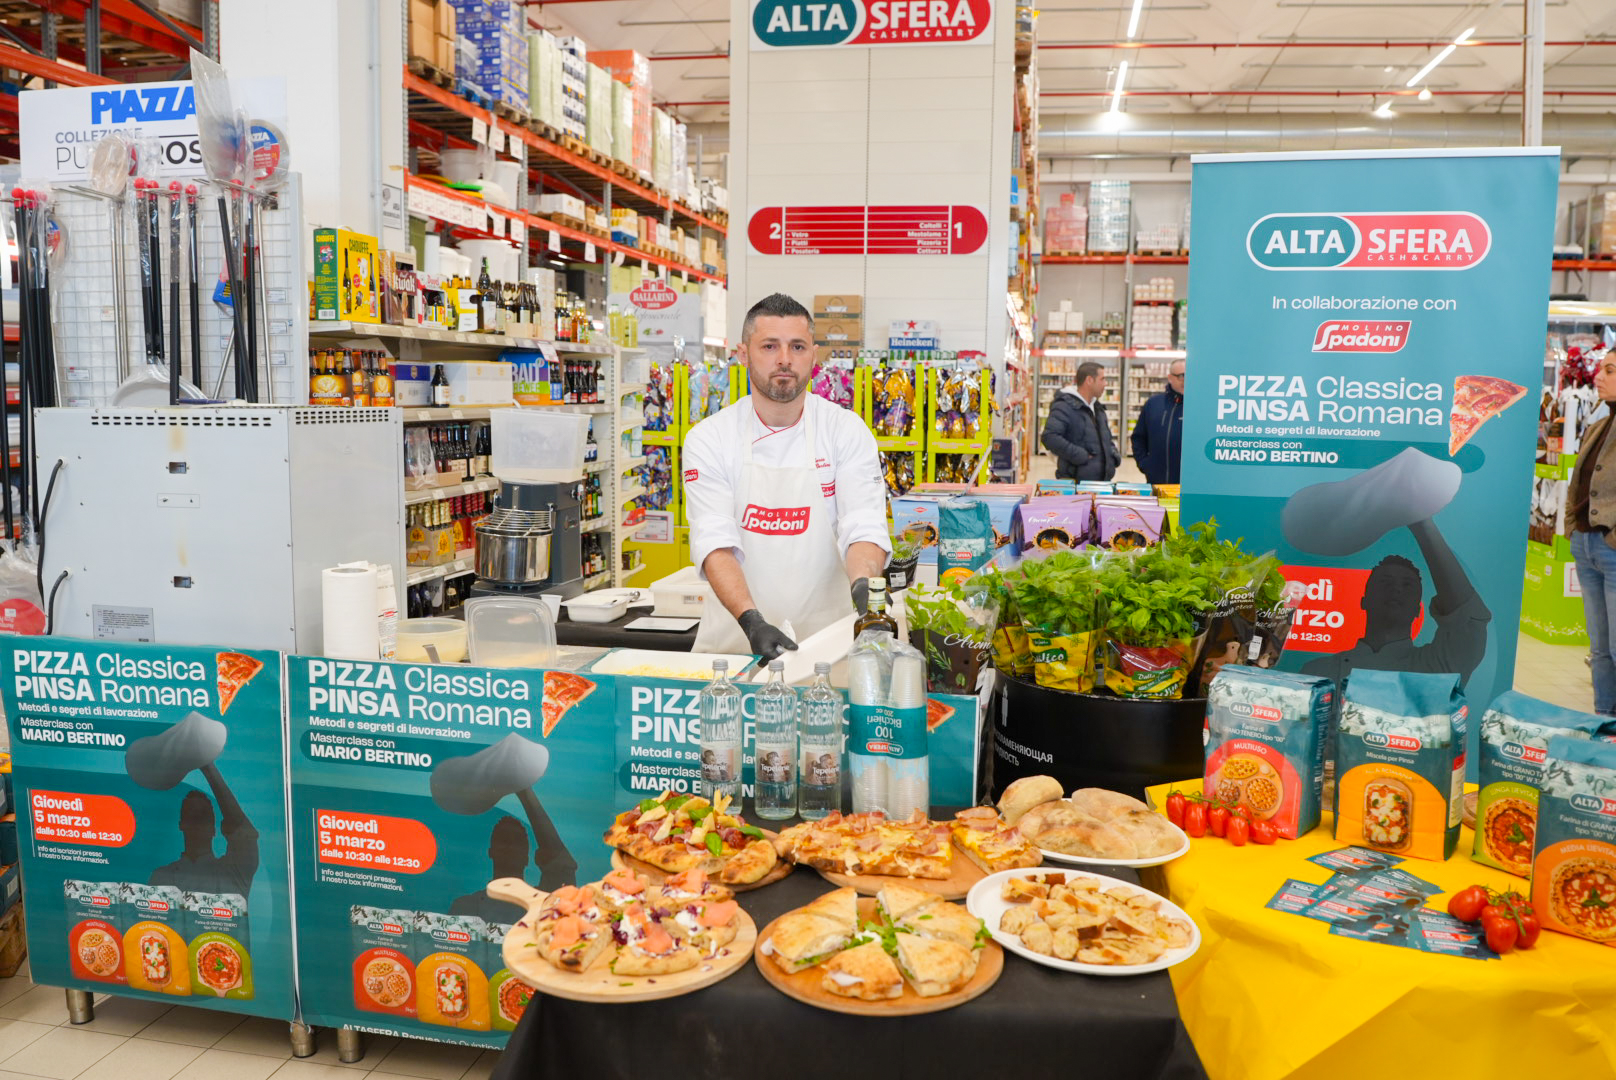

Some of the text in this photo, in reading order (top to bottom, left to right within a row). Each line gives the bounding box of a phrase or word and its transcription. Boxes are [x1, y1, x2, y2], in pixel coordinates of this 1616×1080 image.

[766, 0, 976, 32] ALTA SFERA
[869, 29, 975, 39] CASH&CARRY
[91, 86, 196, 124] PIAZZA
[769, 223, 781, 239] 2
[954, 222, 962, 239] 1
[917, 239, 942, 247] Pizzeria
[1264, 229, 1473, 254] ALTA SFERA
[634, 292, 674, 302] BALLARINI
[1272, 296, 1456, 310] In collaborazione con
[890, 337, 933, 347] Heineken
[1314, 324, 1400, 350] Spadoni
[1218, 375, 1442, 400] PIZZA Classica
[1217, 399, 1442, 425] PINSA Romana
[1216, 424, 1253, 434] Metodi
[1265, 426, 1303, 437] segreti
[1306, 427, 1315, 436] di
[1317, 427, 1380, 437] lavorazione
[1215, 438, 1302, 449] Masterclass con
[1215, 449, 1338, 464] MARIO BERTINO
[742, 508, 804, 531] Spadoni
[759, 510, 806, 518] MOLINO
[1300, 633, 1331, 642] 12:30
[14, 650, 206, 681] PIZZA Classica
[308, 660, 529, 700] PIZZA Classica
[15, 676, 209, 707] PINSA Romana
[18, 702, 49, 712] Metodi
[59, 706, 91, 717] segreti
[93, 707, 102, 716] di
[103, 708, 158, 719] lavorazione
[309, 687, 531, 728] PINSA Romana
[1233, 704, 1279, 718] ALTA SFERA
[20, 717, 93, 730] Masterclass con
[309, 716, 471, 739] Metodi e segreti di lavorazione
[867, 715, 902, 728] Bicchieri
[22, 728, 126, 747] MARIO BERTINO
[875, 726, 893, 739] 100
[310, 732, 395, 749] Masterclass con
[1233, 742, 1267, 754] MULTIUSO
[1366, 735, 1416, 748] ALTA SFERA
[310, 744, 432, 767] MARIO BERTINO
[631, 746, 681, 759] Metodi e
[1504, 744, 1521, 755] ALTA
[631, 763, 701, 778] Masterclass
[1513, 766, 1536, 776] GRANO
[631, 776, 688, 792] MARIO
[33, 795, 83, 812] Giovedì
[1574, 797, 1600, 809] ALTA
[35, 811, 90, 827] 5 marzo
[320, 815, 378, 834] Giovedì
[1560, 814, 1581, 825] Farina
[36, 827, 122, 842] dalle 10:30 alle 12:30
[320, 831, 385, 851] 5 marzo
[57, 848, 82, 856] iscrizioni
[1560, 845, 1585, 855] MEDIA
[73, 855, 109, 864] informazioni.
[321, 848, 420, 868] dalle 10:30 alle 12:30
[326, 876, 347, 884] nostro
[348, 877, 361, 886] box
[362, 880, 404, 892] informazioni.
[344, 870, 373, 881] iscrizioni
[374, 874, 396, 884] presso
[384, 924, 401, 932] SFERA
